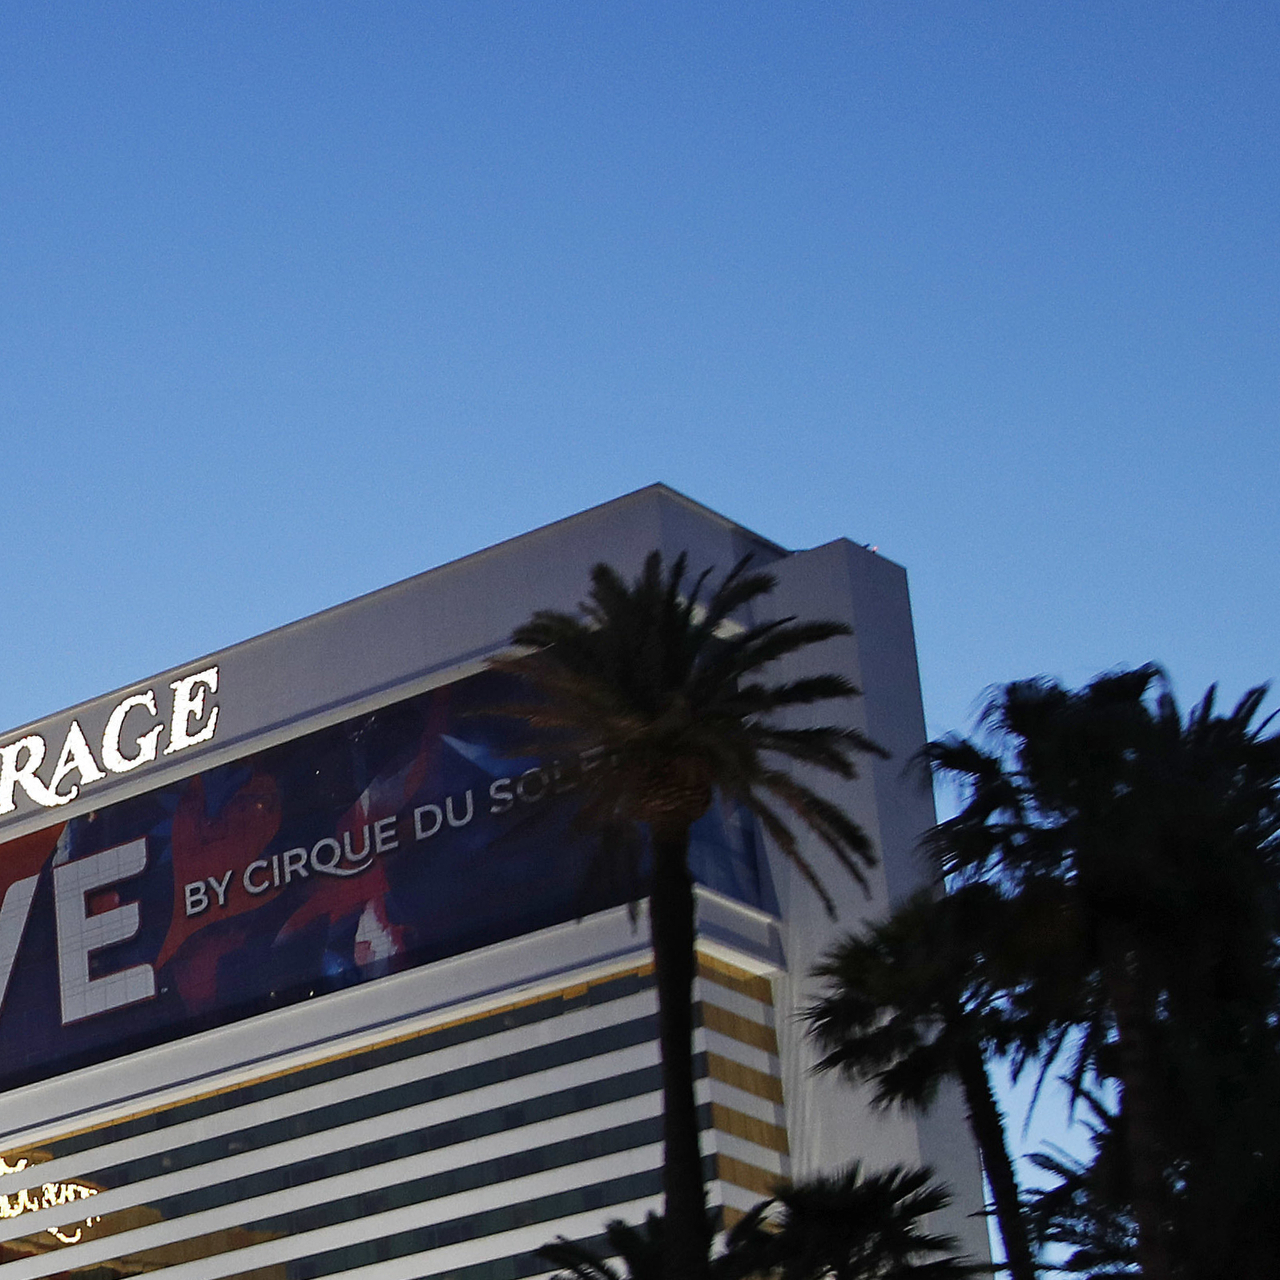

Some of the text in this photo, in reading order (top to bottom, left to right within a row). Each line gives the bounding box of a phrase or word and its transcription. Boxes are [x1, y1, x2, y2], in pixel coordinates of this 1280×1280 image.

[184, 869, 233, 917] BY
[242, 815, 399, 895] CIRQUE
[413, 789, 474, 841] DU
